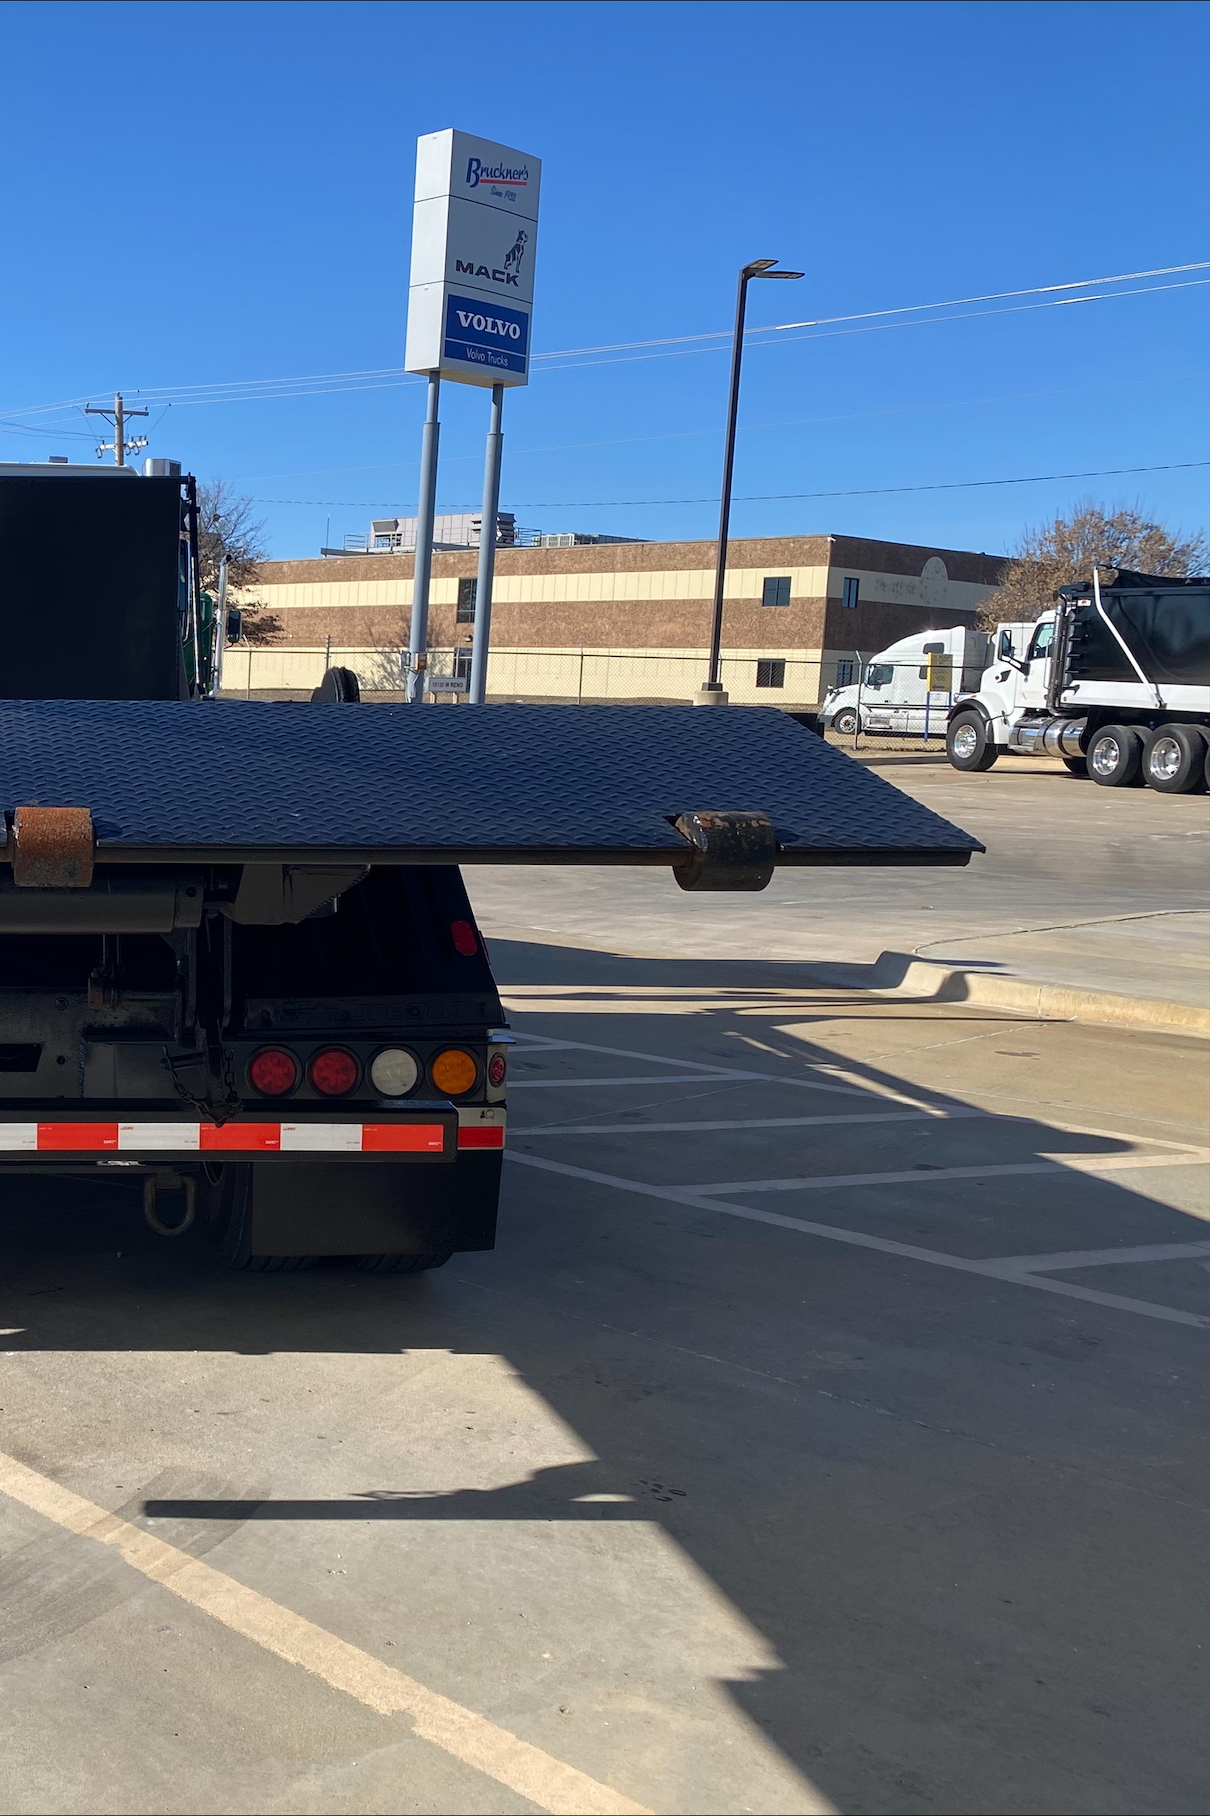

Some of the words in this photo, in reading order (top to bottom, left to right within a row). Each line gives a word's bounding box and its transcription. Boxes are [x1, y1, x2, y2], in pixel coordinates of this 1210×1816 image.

[466, 157, 529, 188] Bruckner's
[490, 185, 503, 198] Since
[455, 259, 520, 288] MACK
[456, 310, 521, 340] VOLVO
[466, 347, 486, 362] Volvo
[487, 351, 509, 367] Trucks
